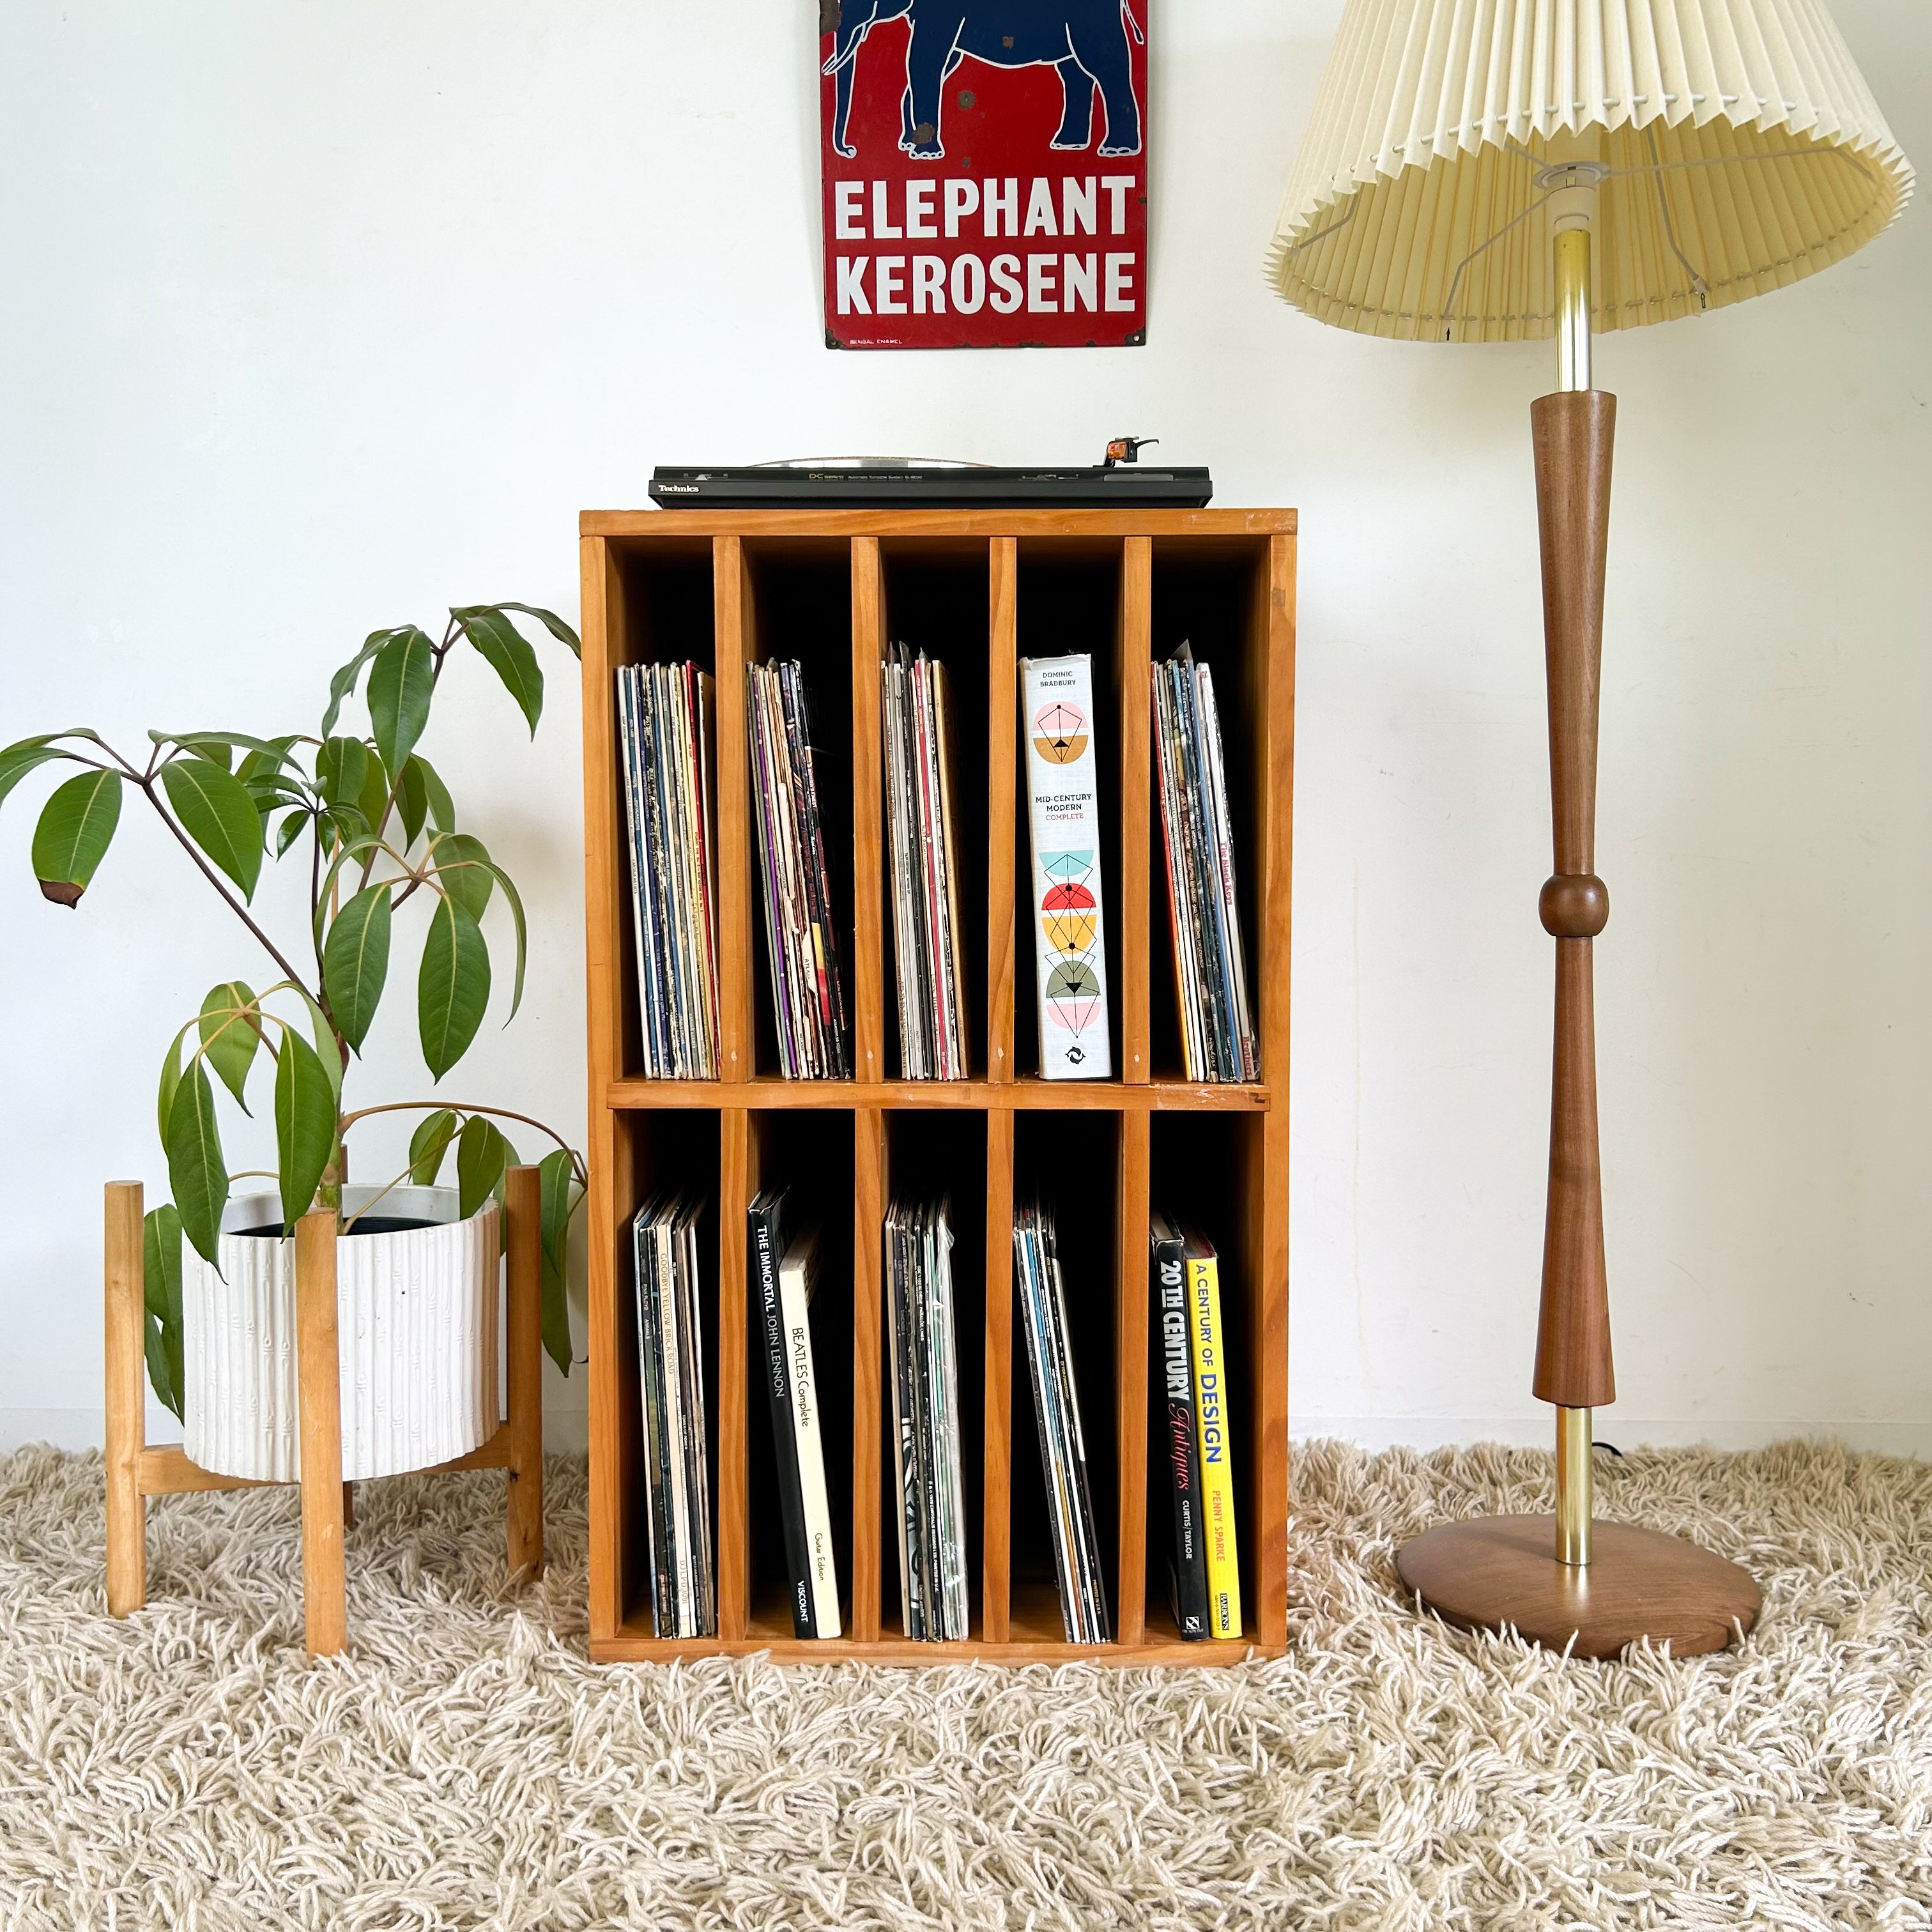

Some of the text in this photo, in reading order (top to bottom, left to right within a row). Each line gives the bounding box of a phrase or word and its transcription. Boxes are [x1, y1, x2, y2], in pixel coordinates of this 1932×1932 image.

[835, 175, 1135, 239] ELEPHANT
[836, 253, 1135, 314] KEROSENE
[1036, 793, 1092, 803] MID-CENTURY
[1046, 804, 1082, 812] MODERN
[1220, 841, 1234, 905] The Black Keys
[1241, 1036, 1254, 1076] Brothers
[660, 1253, 668, 1291] GOODBYE
[662, 1294, 670, 1326] YELLOW
[757, 1225, 785, 1397] THE IMMORTAL JOHN LENNON
[1160, 1260, 1190, 1401] 20TH CENTURY
[792, 1328, 811, 1427] BEATLES Complete
[1196, 1264, 1222, 1462] A CENTURY OF DESIGN
[1169, 1403, 1192, 1491] Antiques
[1212, 1490, 1225, 1563] PENNY SPARKE
[817, 1556, 825, 1581] Edition
[798, 1580, 809, 1623] VISCOUNT
